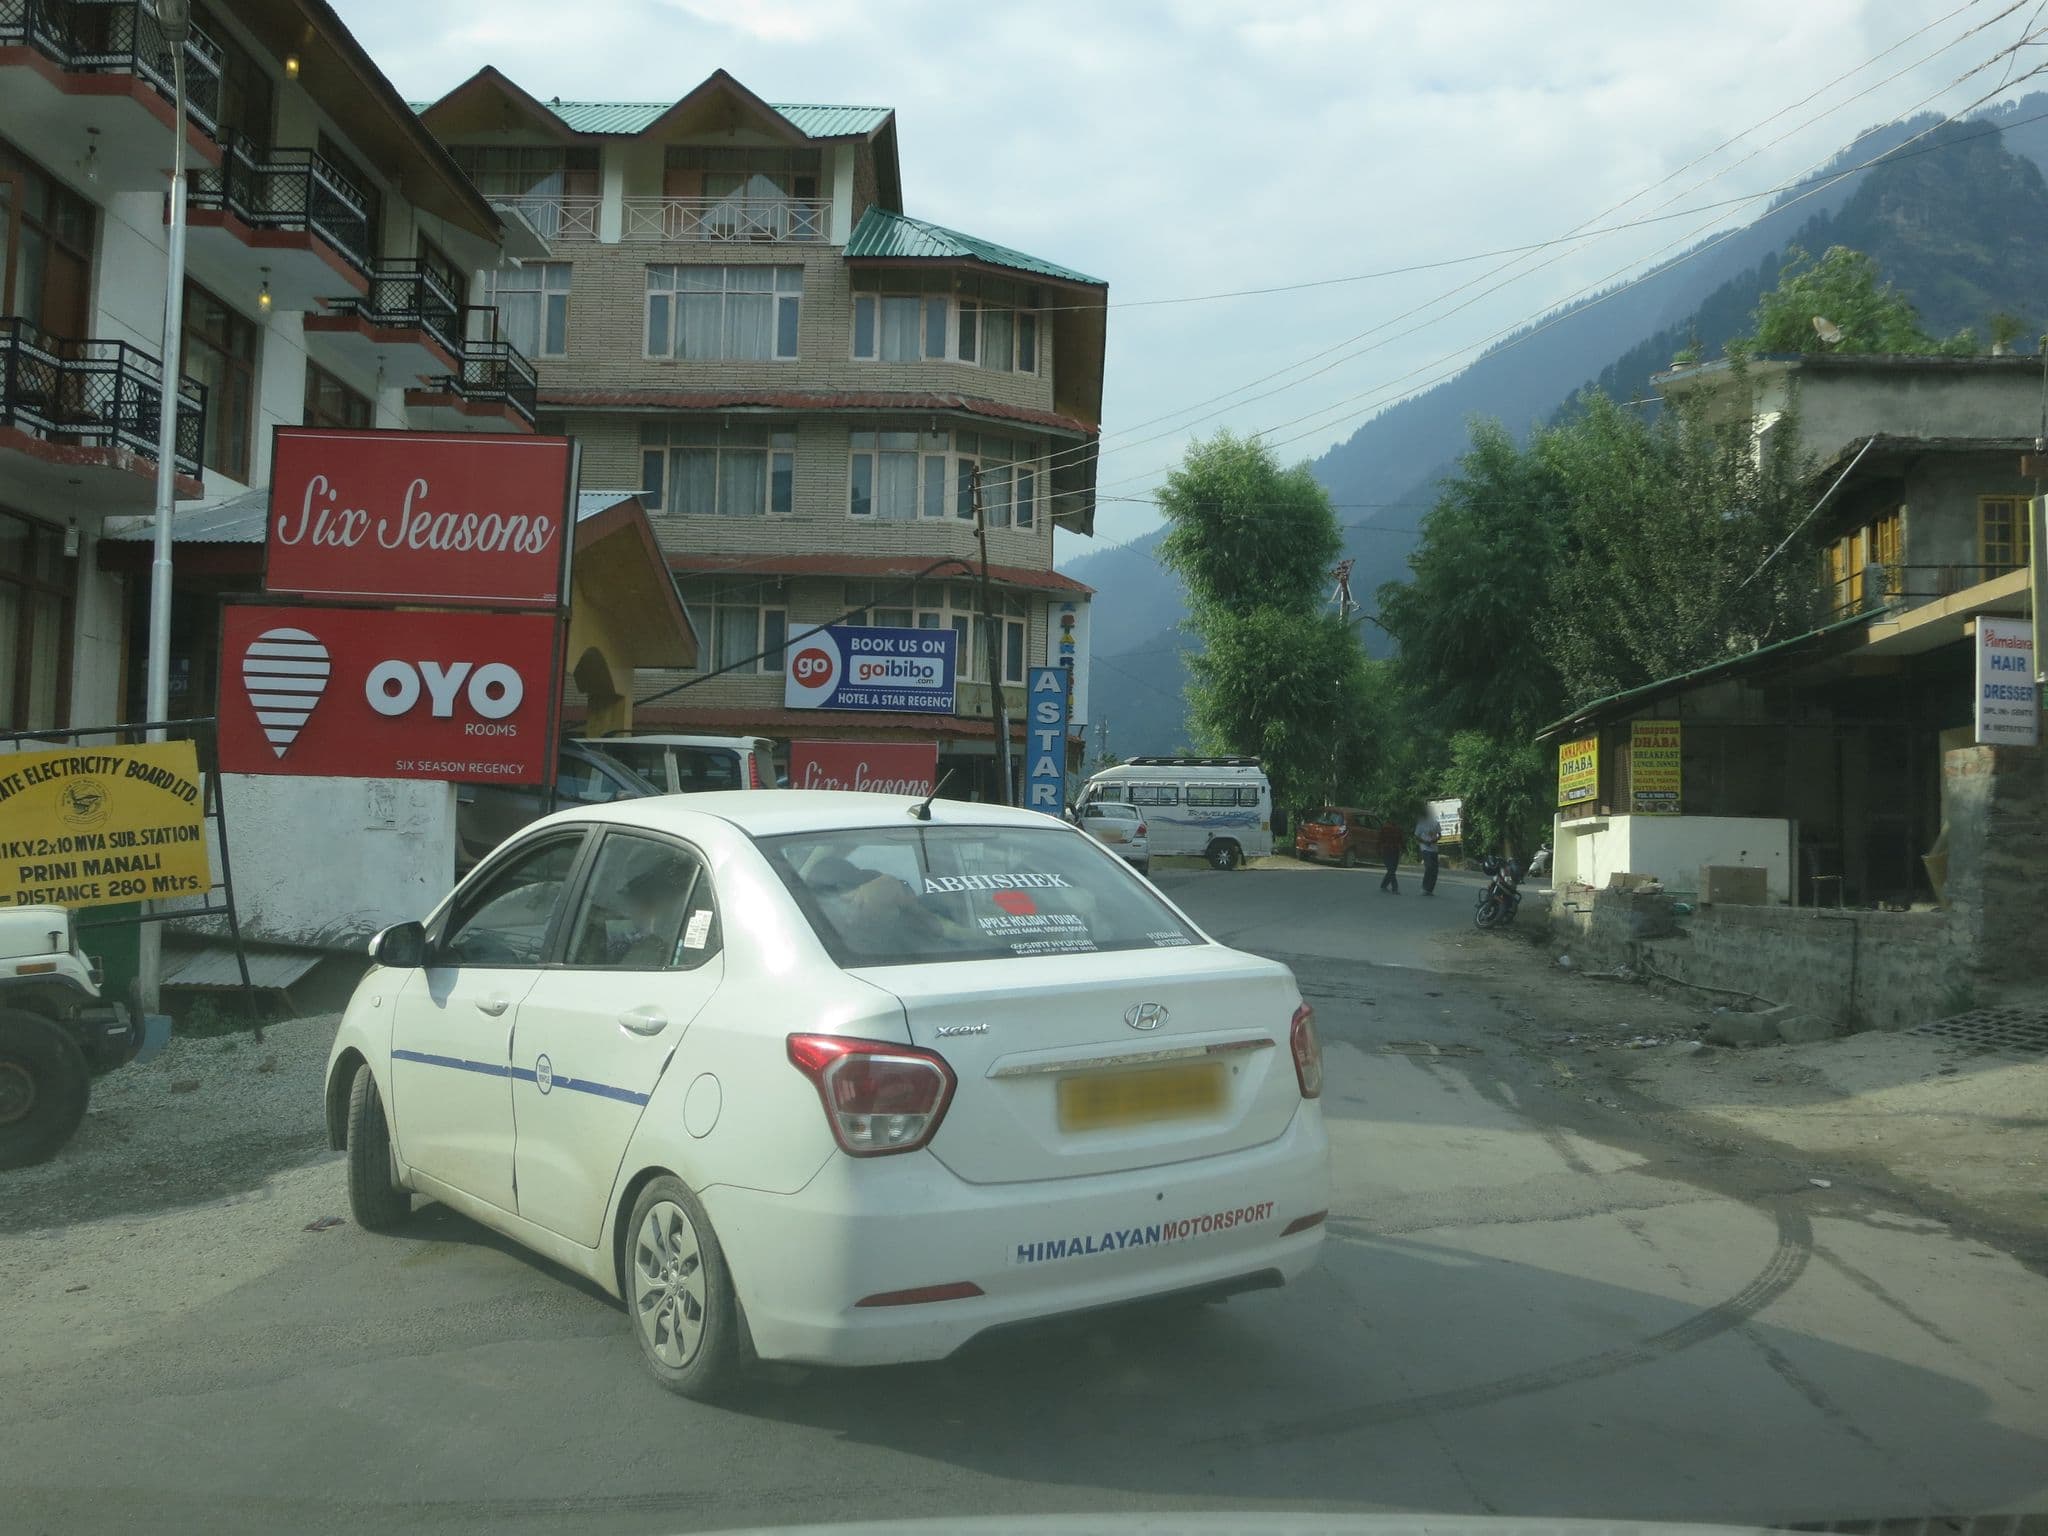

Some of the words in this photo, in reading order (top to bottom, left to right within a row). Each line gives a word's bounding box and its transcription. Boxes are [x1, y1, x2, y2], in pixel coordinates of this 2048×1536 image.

[278, 474, 371, 547] Six
[377, 478, 556, 554] Seasons
[851, 638, 895, 652] BOOK
[899, 640, 917, 653] US
[922, 641, 945, 653] ON
[798, 657, 828, 678] go
[859, 659, 934, 680] goibibo
[1991, 655, 2027, 673] HAIR
[365, 659, 523, 719] OYO
[1984, 684, 2033, 702] DRESSER
[838, 693, 870, 705] HOTEL
[871, 695, 879, 705] A
[882, 695, 905, 706] STAR
[908, 695, 953, 708] REGENCY
[465, 723, 517, 737] ROOMS
[1633, 737, 1679, 748] DHABA
[396, 760, 414, 771] SIX
[417, 761, 465, 773] SEASON
[469, 762, 525, 774] REGENCY
[1562, 755, 1593, 776] DHABA
[23, 756, 124, 786] ELECTRICITY
[125, 760, 173, 790] BOARD
[170, 778, 199, 806] LTD.
[843, 762, 934, 796] Seasons
[75, 834, 106, 851] MVA
[19, 861, 77, 883] PRINI
[83, 853, 161, 876] MANALI
[16, 883, 101, 906] DISTANCE
[108, 878, 147, 897] 280
[152, 875, 202, 893] Mtrs.
[924, 872, 1073, 894] ABHISHEK
[978, 917, 1011, 929] APPLE
[1007, 915, 1050, 928] HOLIDAY
[1049, 914, 1083, 926] TOURS
